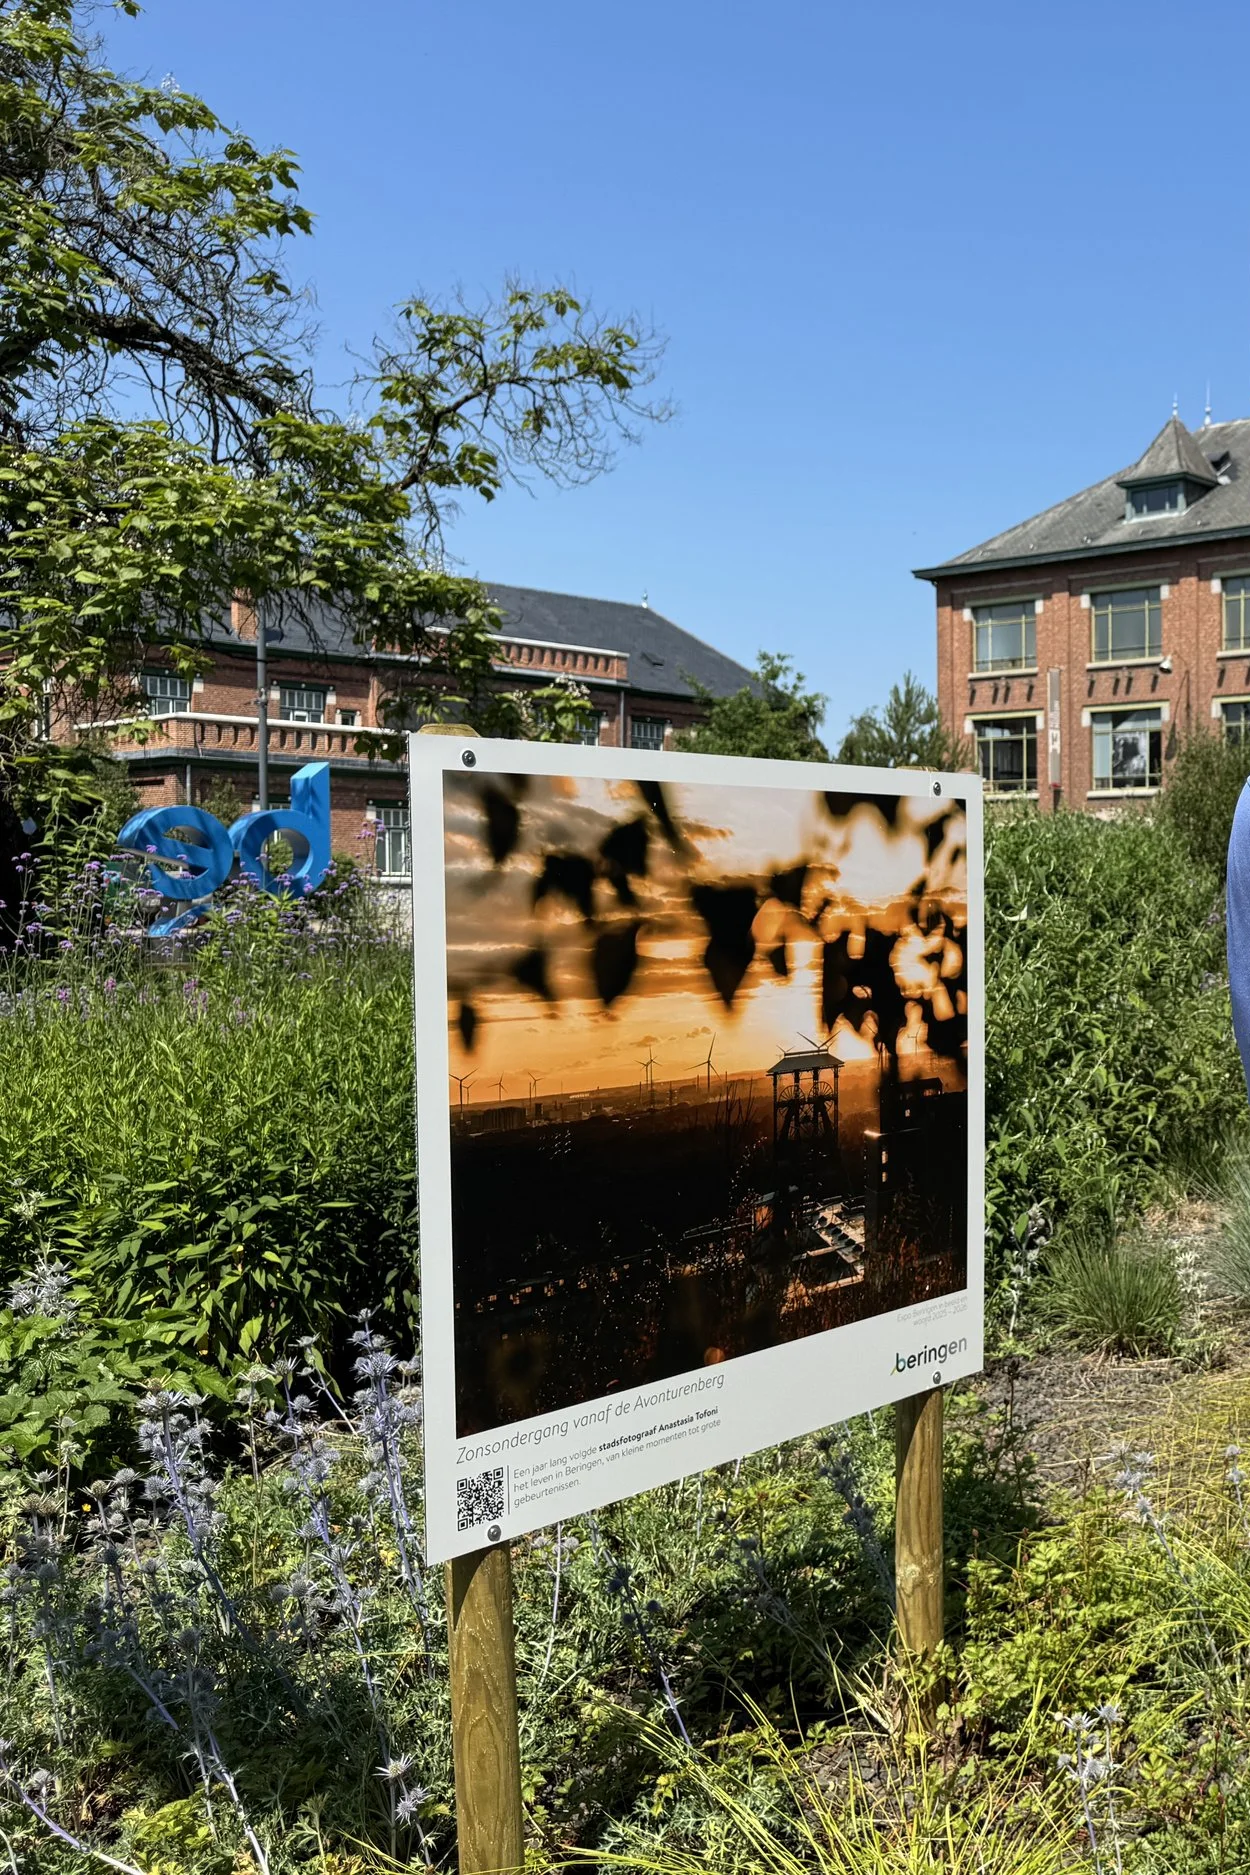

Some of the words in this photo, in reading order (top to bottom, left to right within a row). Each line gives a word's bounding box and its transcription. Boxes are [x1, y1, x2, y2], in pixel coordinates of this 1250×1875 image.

[895, 1337, 968, 1373] beringen
[456, 1420, 569, 1465] Zonsondergang
[573, 1403, 613, 1430] vanaf
[614, 1400, 631, 1417] de
[633, 1374, 725, 1412] Avonturenberg
[513, 1466, 531, 1479] Een
[532, 1462, 548, 1476] jaar
[549, 1456, 568, 1469] lang
[569, 1446, 597, 1462] volgde
[598, 1425, 658, 1452] stadsfotograaf
[658, 1415, 694, 1433] Anastasia
[695, 1405, 719, 1421] Tofoni
[513, 1481, 529, 1493] het
[530, 1474, 554, 1488] leven
[555, 1469, 563, 1480] in
[565, 1457, 605, 1477] Beringen,
[605, 1452, 620, 1463] van
[621, 1443, 645, 1458] kleine
[645, 1429, 687, 1450] momenten
[688, 1423, 700, 1435] tot
[700, 1418, 721, 1434] grote
[513, 1478, 581, 1508] gebeurtenissen.
